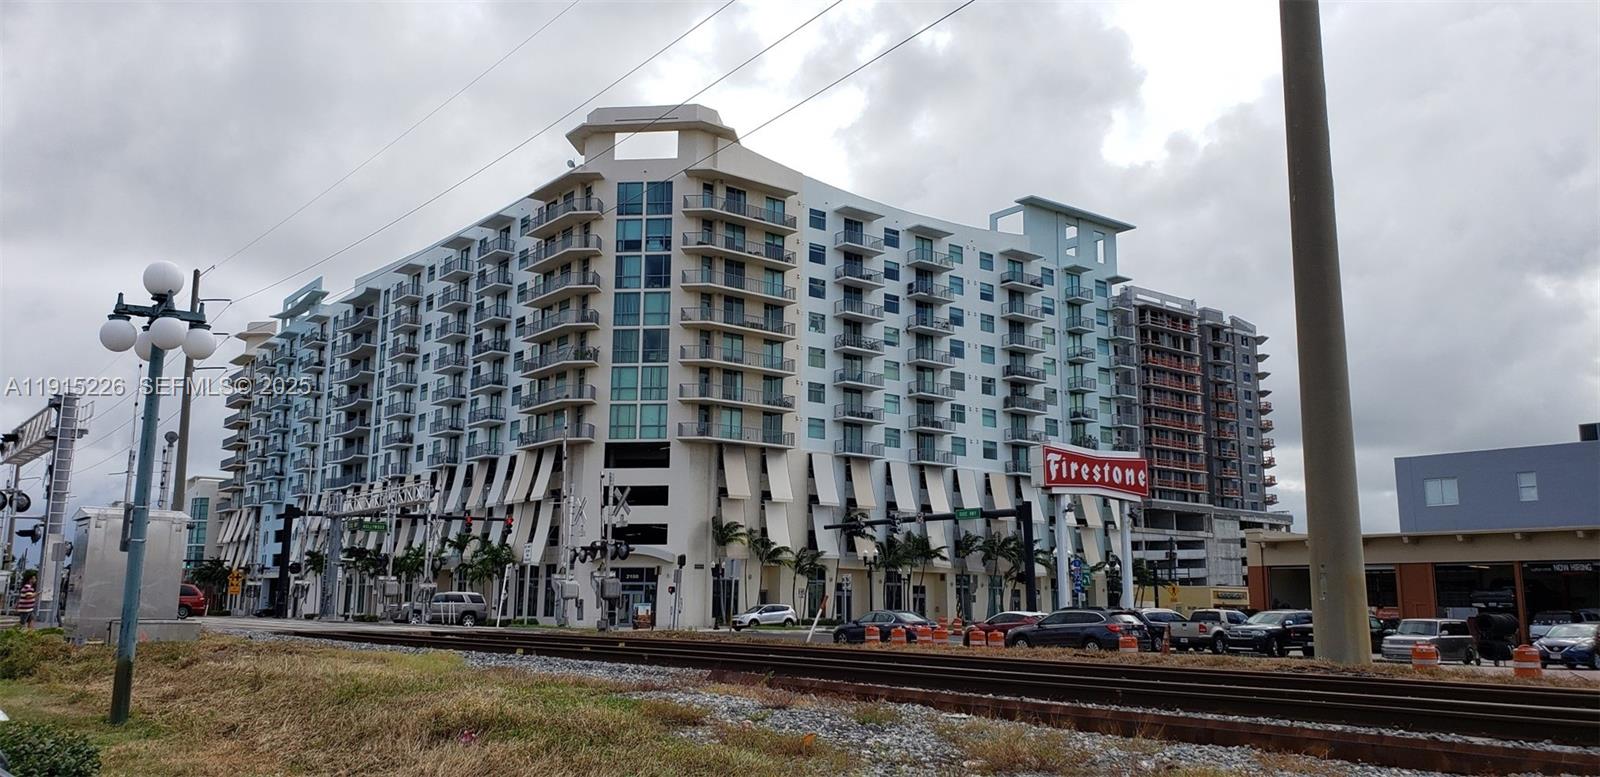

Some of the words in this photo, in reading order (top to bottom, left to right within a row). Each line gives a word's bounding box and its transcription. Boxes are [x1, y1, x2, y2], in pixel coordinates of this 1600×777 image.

[1046, 452, 1146, 487] Firestone
[1552, 563, 1569, 572] NOW
[1570, 563, 1592, 572] HIRING
